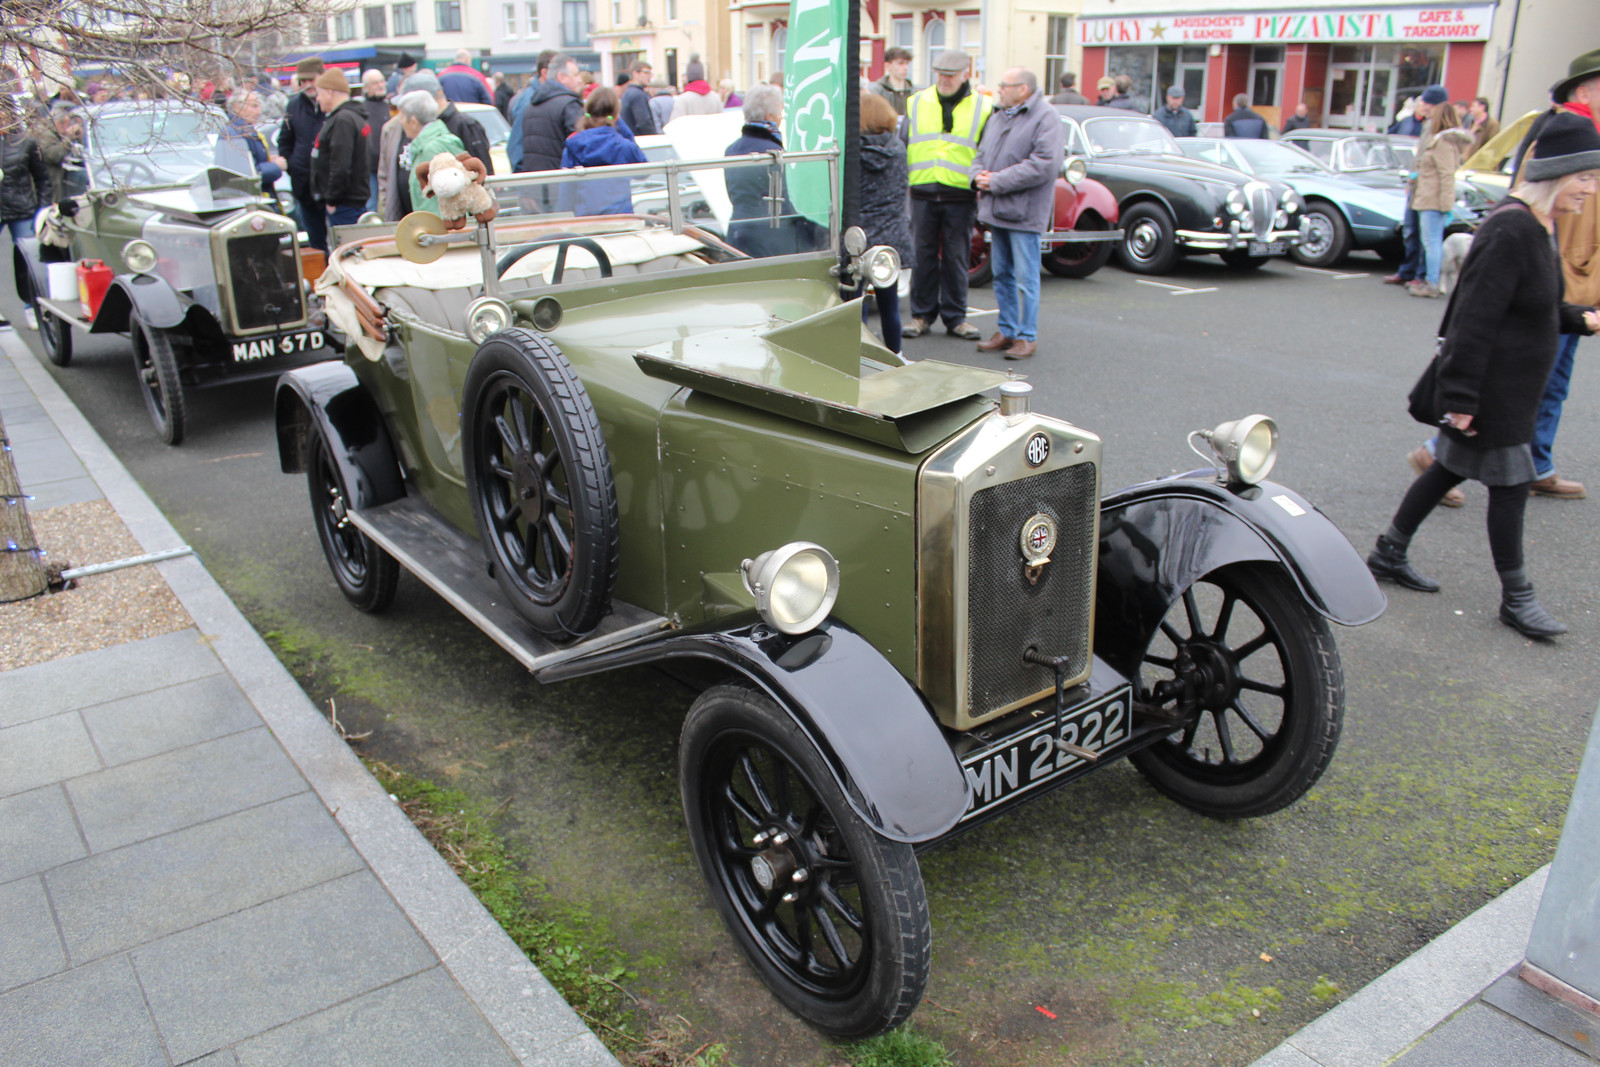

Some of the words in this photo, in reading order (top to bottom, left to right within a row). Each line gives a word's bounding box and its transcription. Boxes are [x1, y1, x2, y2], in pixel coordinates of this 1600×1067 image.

[1173, 16, 1245, 28] AMUSEMENTS
[1255, 14, 1395, 38] PIZZANISTA
[1418, 10, 1452, 23] CAFE
[1455, 10, 1464, 22] &
[1082, 19, 1144, 43] LUCKY
[1193, 29, 1233, 39] GAMING
[1403, 25, 1480, 37] TAKEAWAY
[233, 338, 275, 362] MAN
[1028, 436, 1049, 464] ABC
[966, 746, 1018, 810] MN
[1030, 700, 1125, 780] 2222
